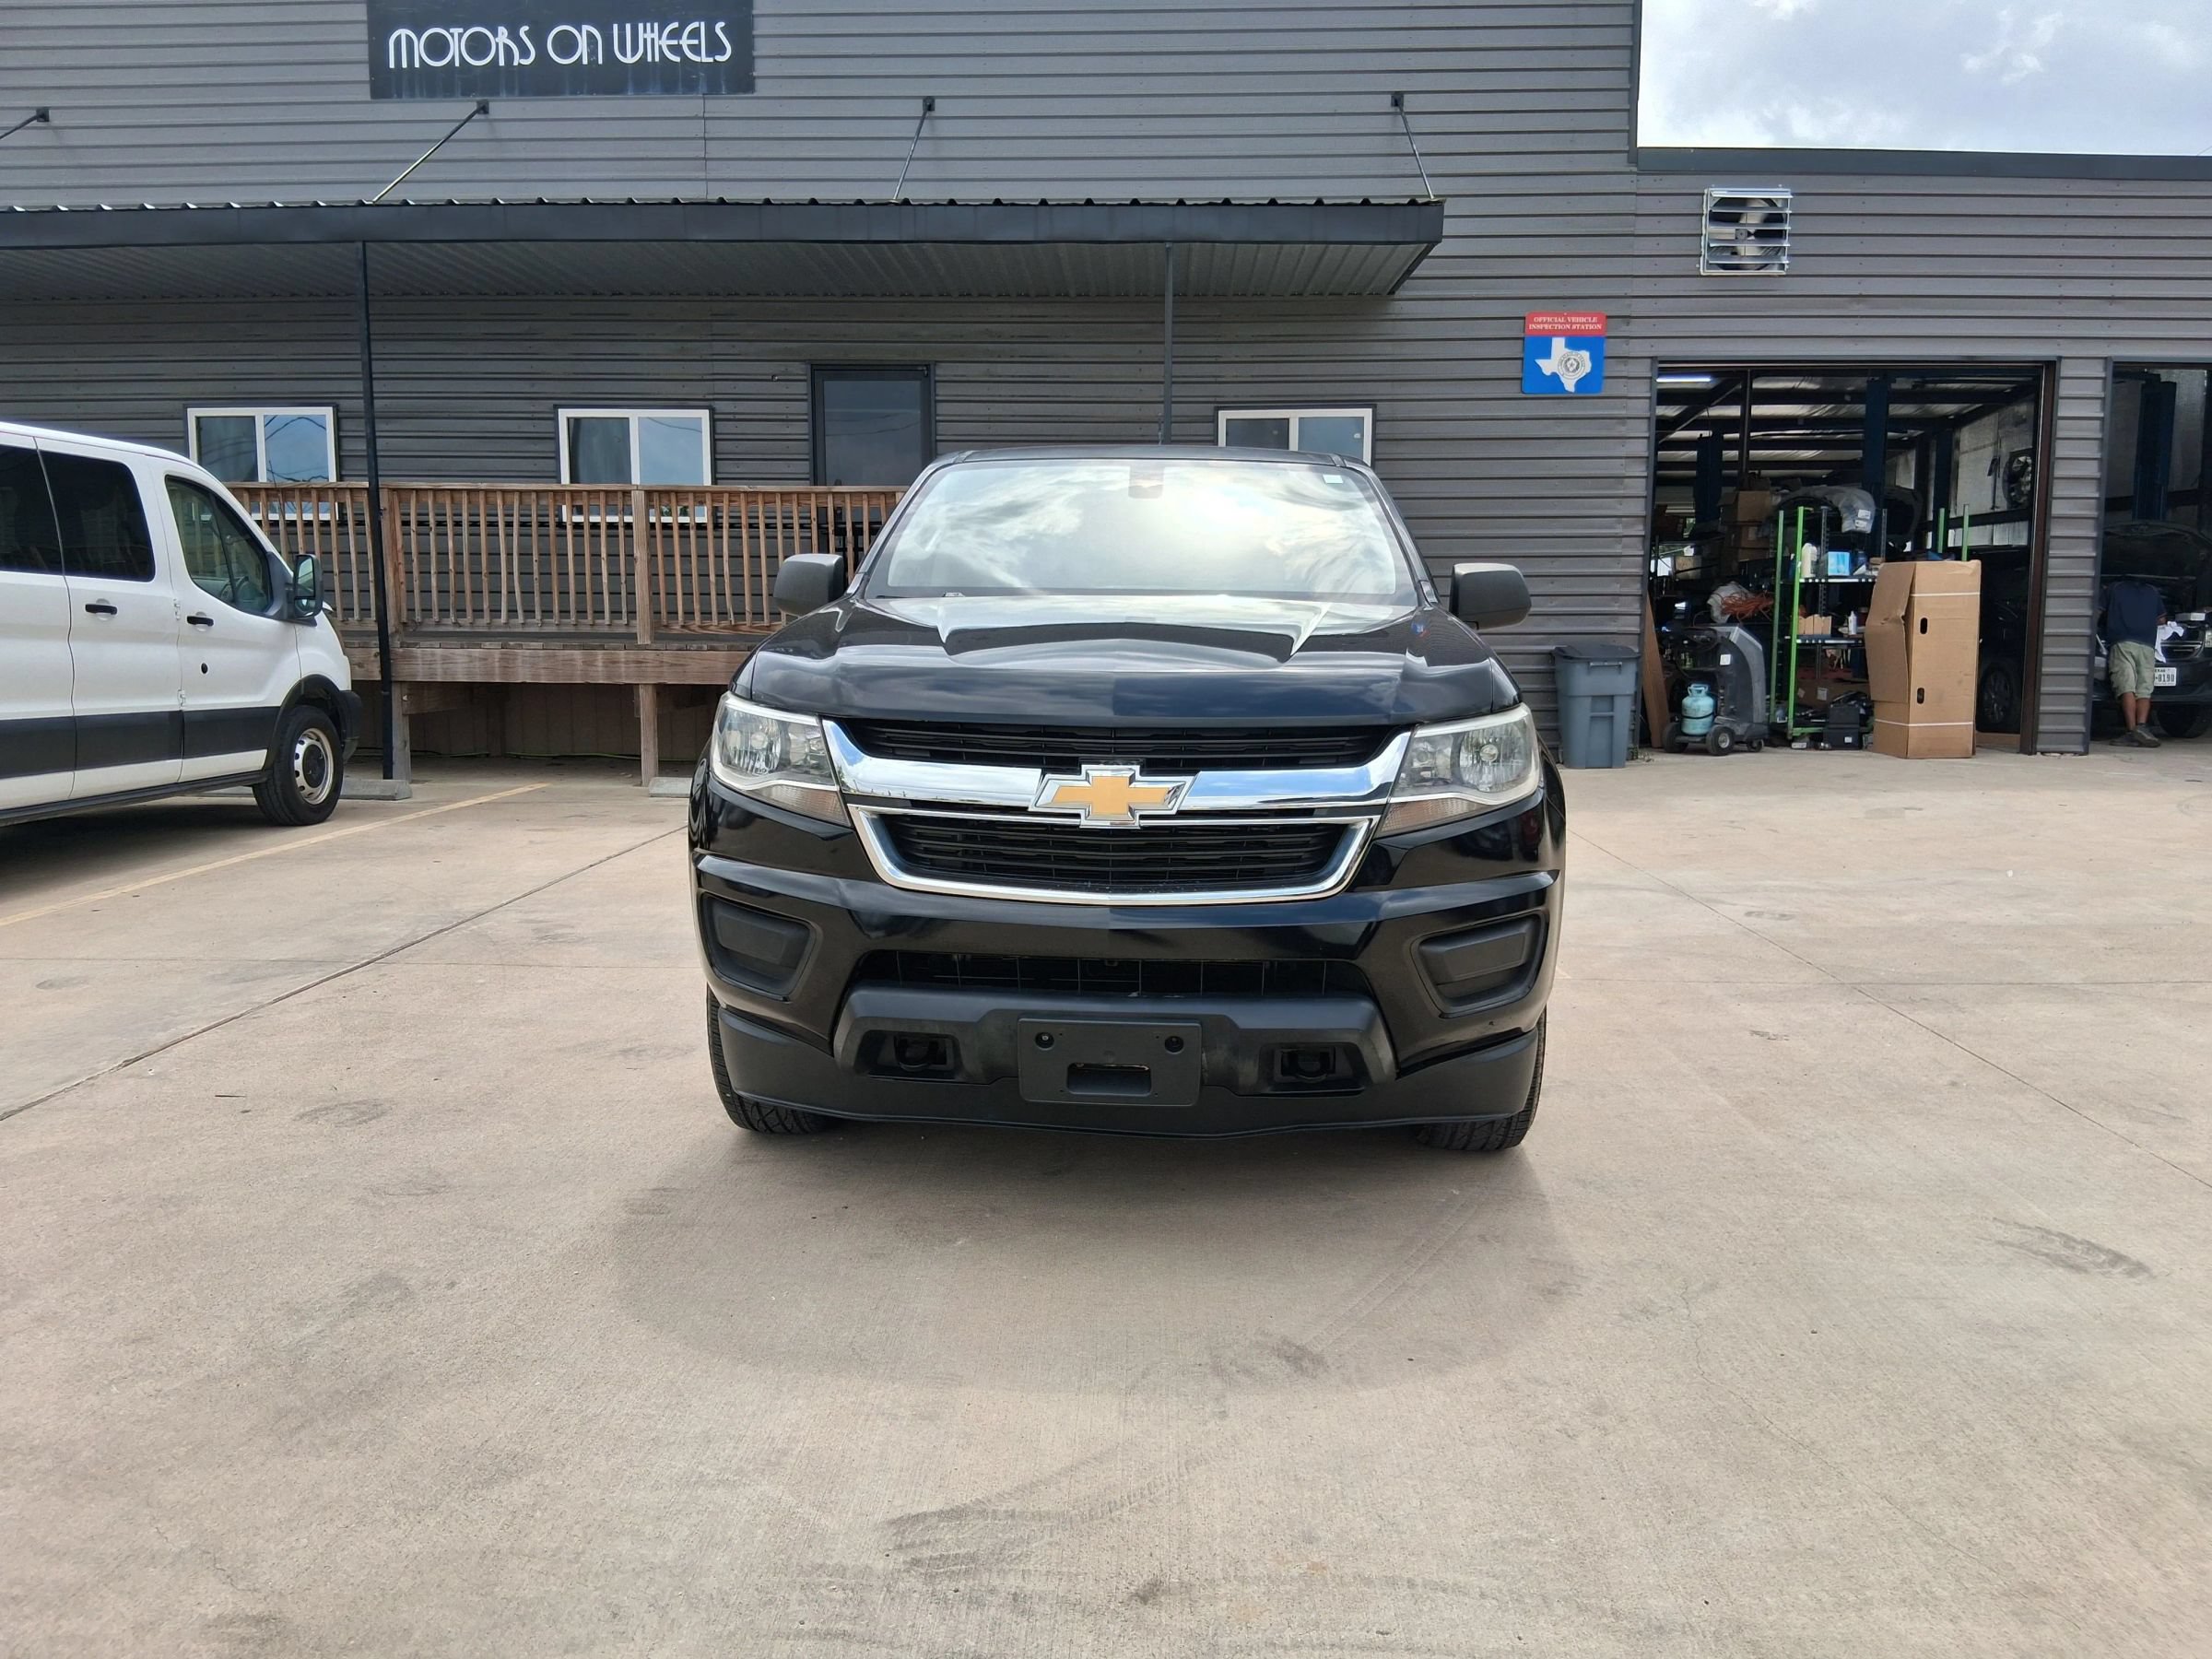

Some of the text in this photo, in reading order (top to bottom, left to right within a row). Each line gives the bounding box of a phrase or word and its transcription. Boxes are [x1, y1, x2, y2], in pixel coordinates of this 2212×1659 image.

[388, 21, 732, 69] MOTORS ON WHEELS
